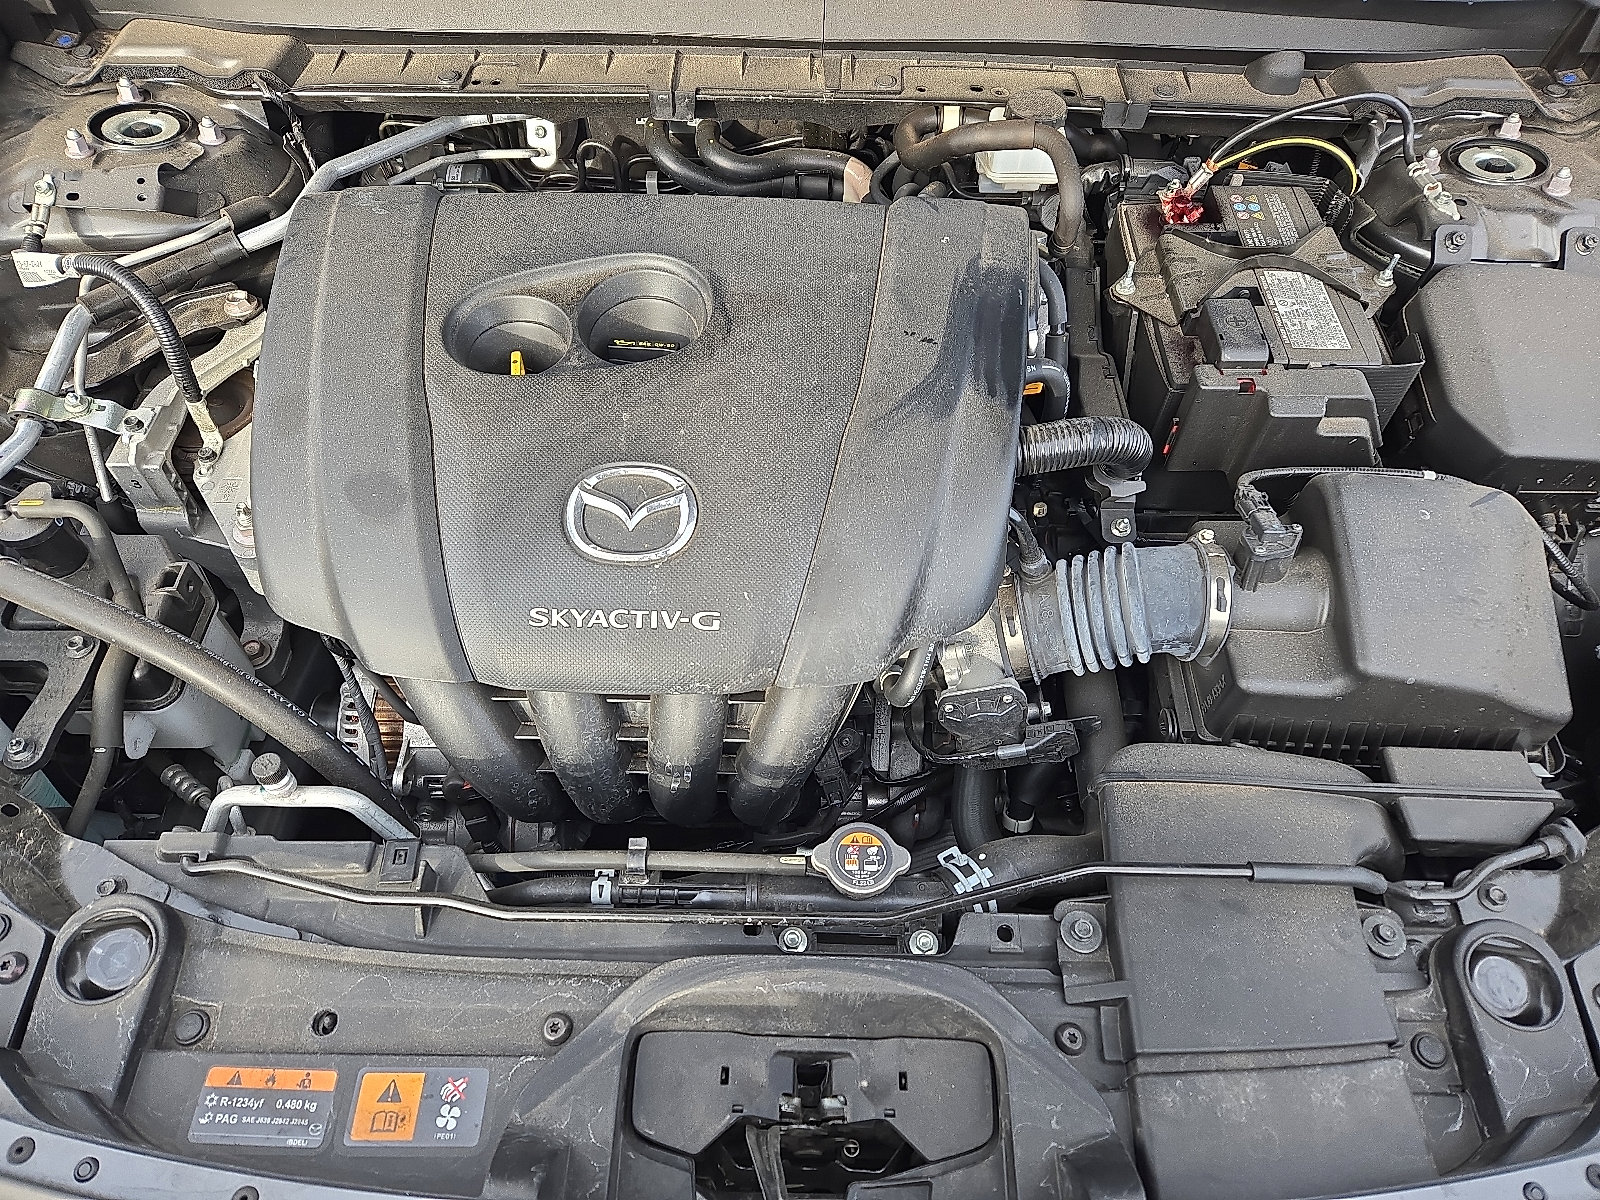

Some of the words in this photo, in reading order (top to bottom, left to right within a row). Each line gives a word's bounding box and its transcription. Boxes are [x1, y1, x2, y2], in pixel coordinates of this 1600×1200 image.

[528, 606, 722, 632] SKYACTIV-G
[263, 686, 306, 717] GALAXY
[219, 1096, 265, 1110] R-1234yf
[275, 1098, 303, 1110] 0.480
[303, 1100, 318, 1112] kg
[215, 1113, 238, 1124] PAG
[241, 1116, 256, 1124] SAE
